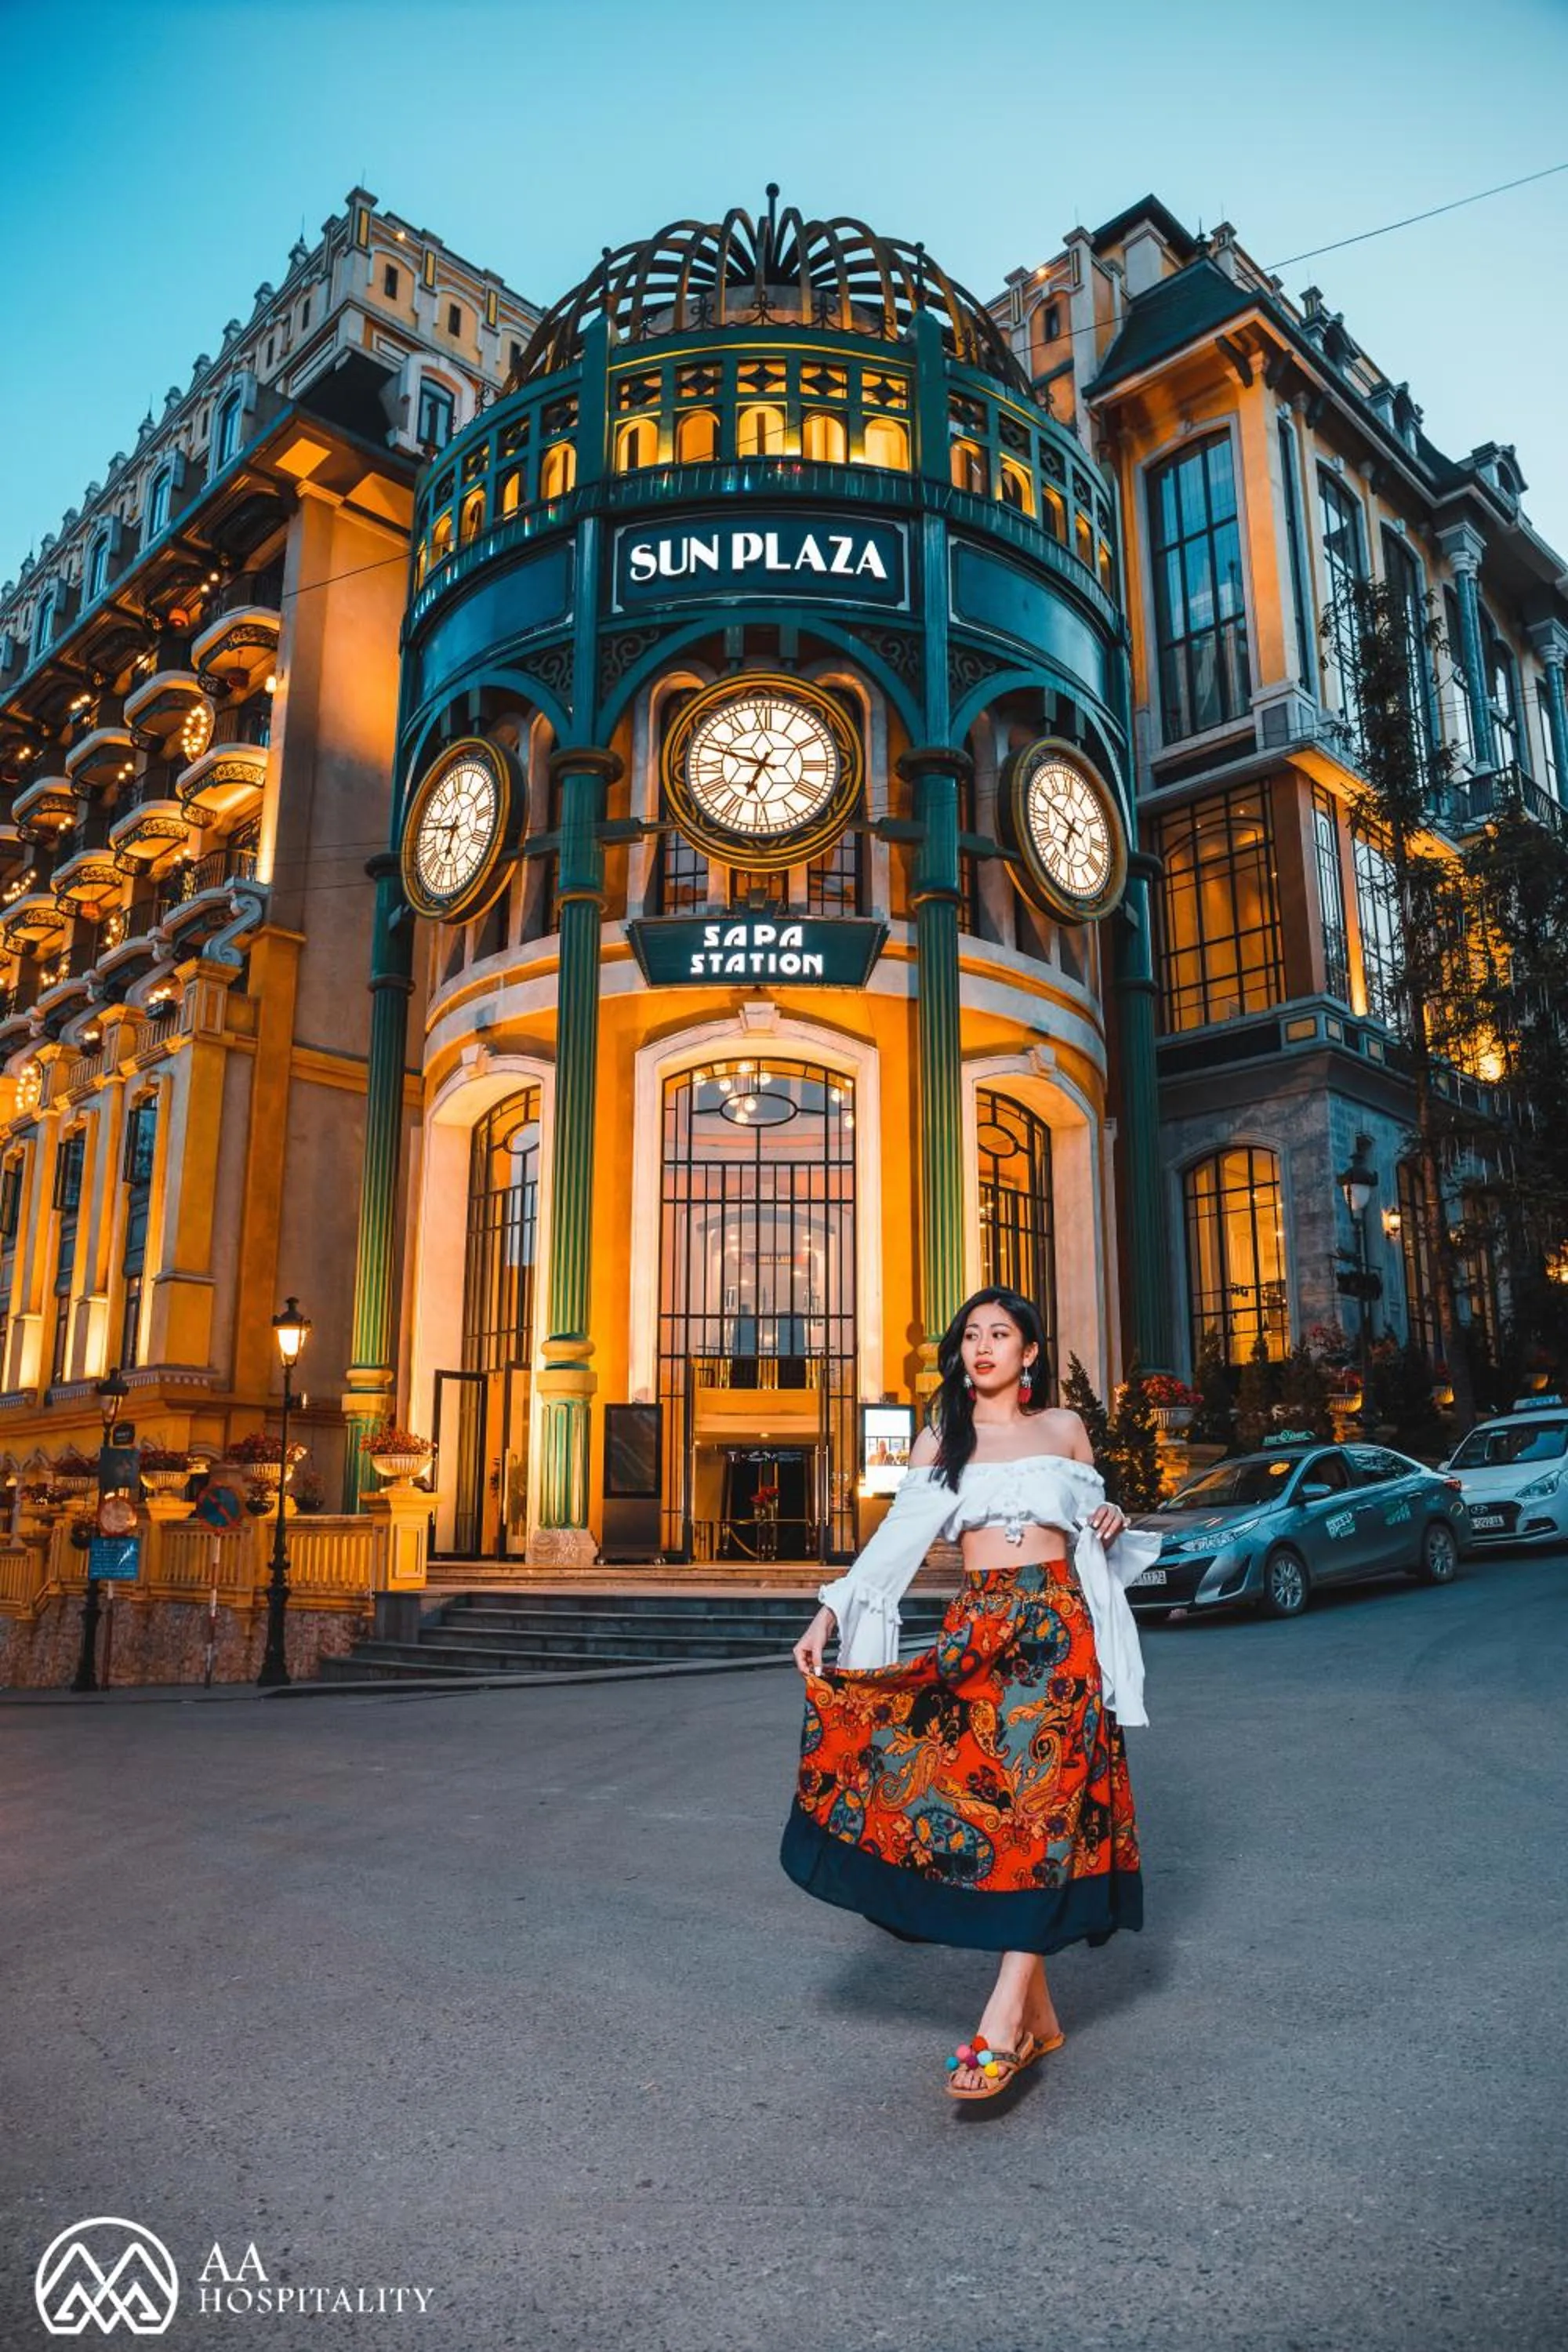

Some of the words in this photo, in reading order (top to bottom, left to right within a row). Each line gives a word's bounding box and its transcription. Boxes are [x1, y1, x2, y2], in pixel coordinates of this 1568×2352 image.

[630, 534, 719, 581] SUN
[731, 532, 888, 579] PLAZA
[703, 924, 804, 948] SAPA
[690, 952, 824, 975] STATION
